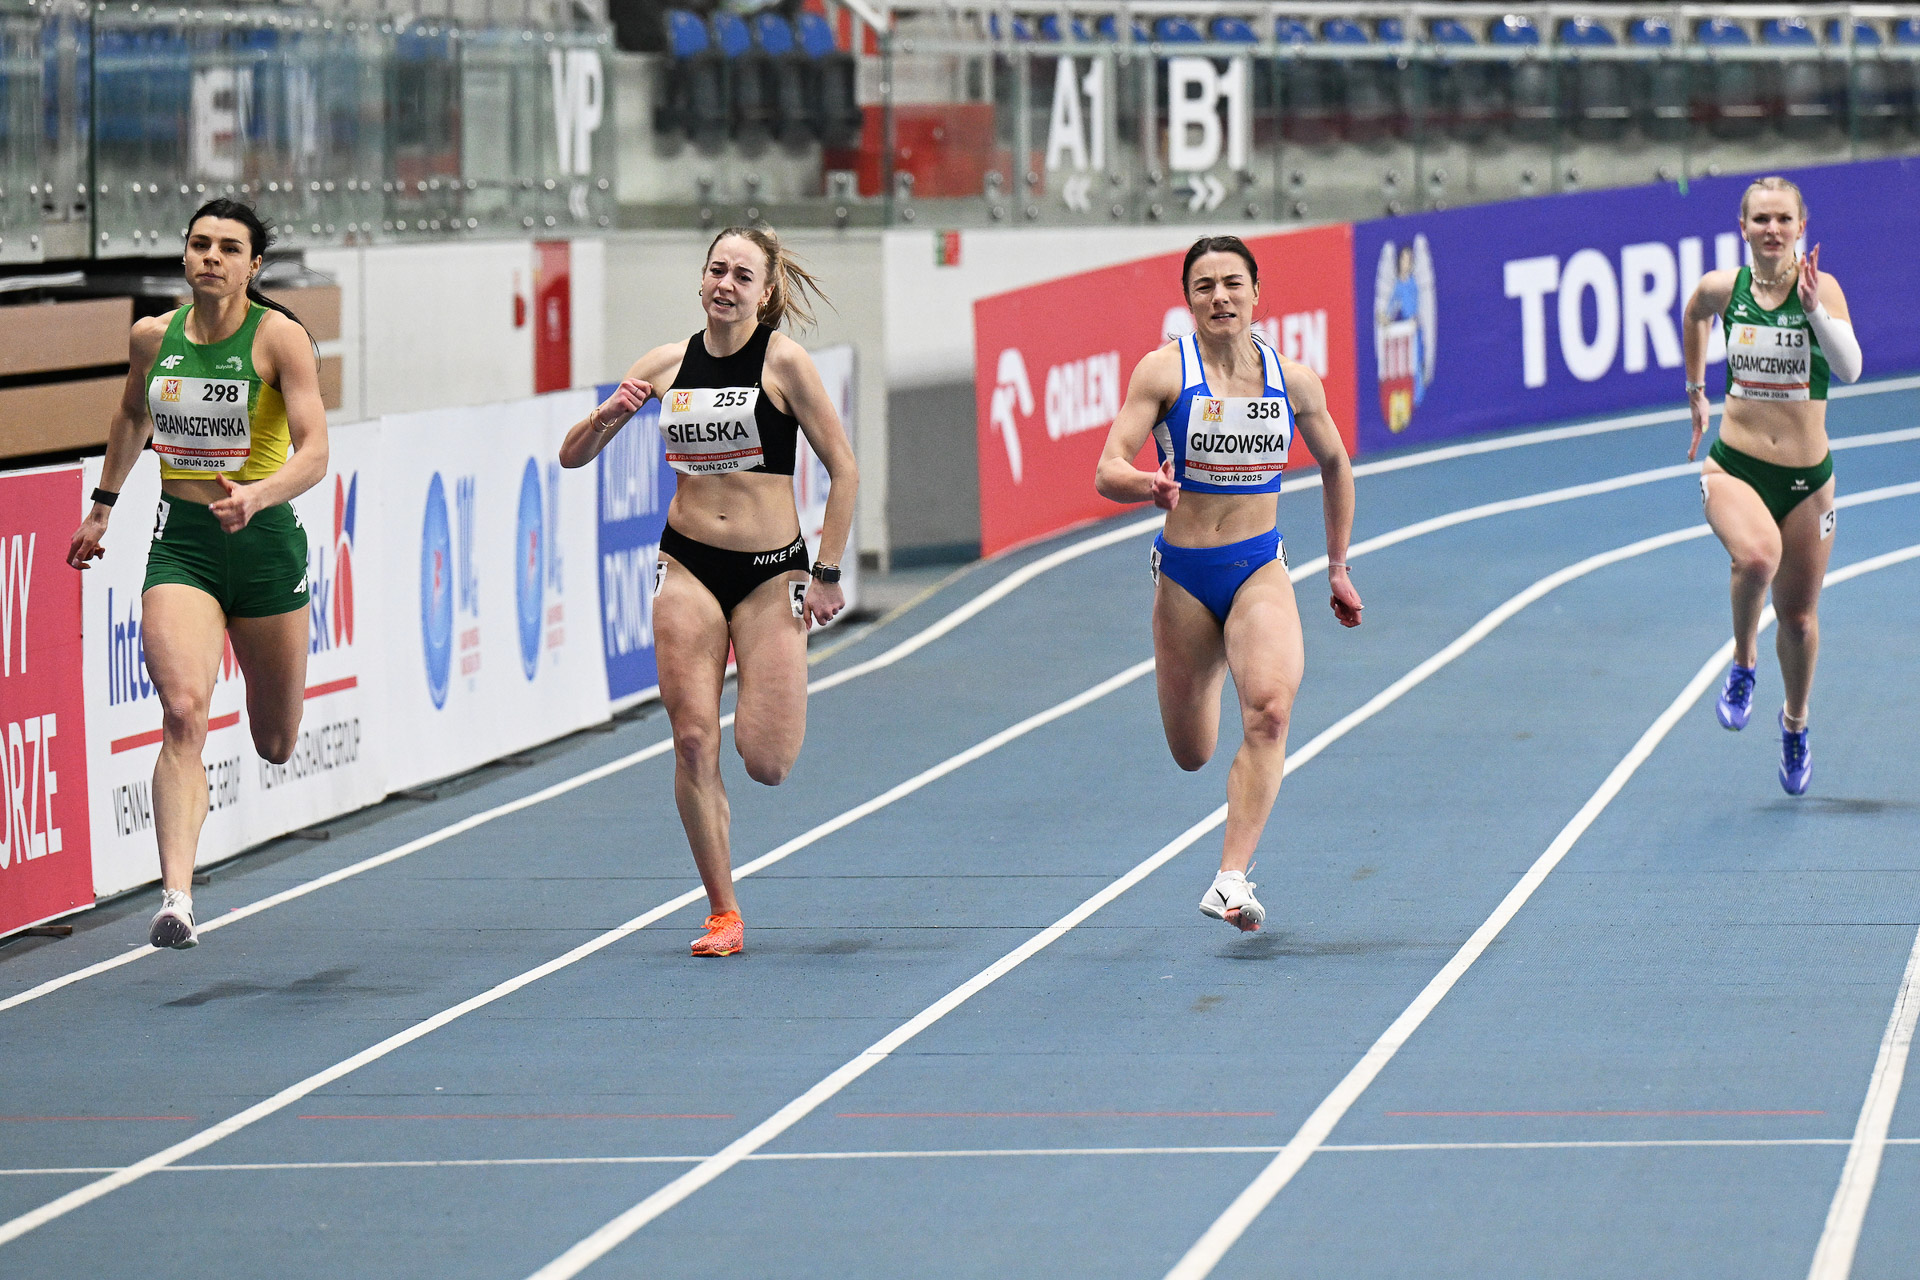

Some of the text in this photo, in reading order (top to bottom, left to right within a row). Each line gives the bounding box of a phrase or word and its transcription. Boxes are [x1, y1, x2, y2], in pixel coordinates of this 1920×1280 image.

[549, 48, 603, 175] VP
[1045, 57, 1104, 171] A1
[1168, 58, 1247, 171] B1
[1503, 233, 1814, 389] TORU
[1775, 331, 1804, 348] 113
[160, 355, 185, 370] 4F
[1731, 354, 1807, 375] ADAMCZEWSKA
[202, 383, 240, 403] 298
[712, 391, 749, 408] 255
[1045, 351, 1121, 440] ORLEN
[1246, 402, 1281, 420] 358
[155, 412, 246, 437] GRANASZEWSKA
[667, 420, 749, 443] SIELSKA
[195, 449, 229, 457] Mistrzostwa
[1190, 432, 1285, 454] GUZOWSKA
[173, 457, 202, 467] TORUŃ
[708, 450, 741, 460] Mistrzostwa
[742, 448, 759, 456] Polski
[688, 461, 739, 472] TORUŃ 2025
[1235, 464, 1266, 472] Mistrzostwa
[1209, 473, 1263, 483] TORUŃ 2025
[1825, 510, 1835, 533] 3
[753, 550, 788, 566] NIKE
[794, 584, 806, 615] 5
[112, 779, 152, 838] VIENNA
